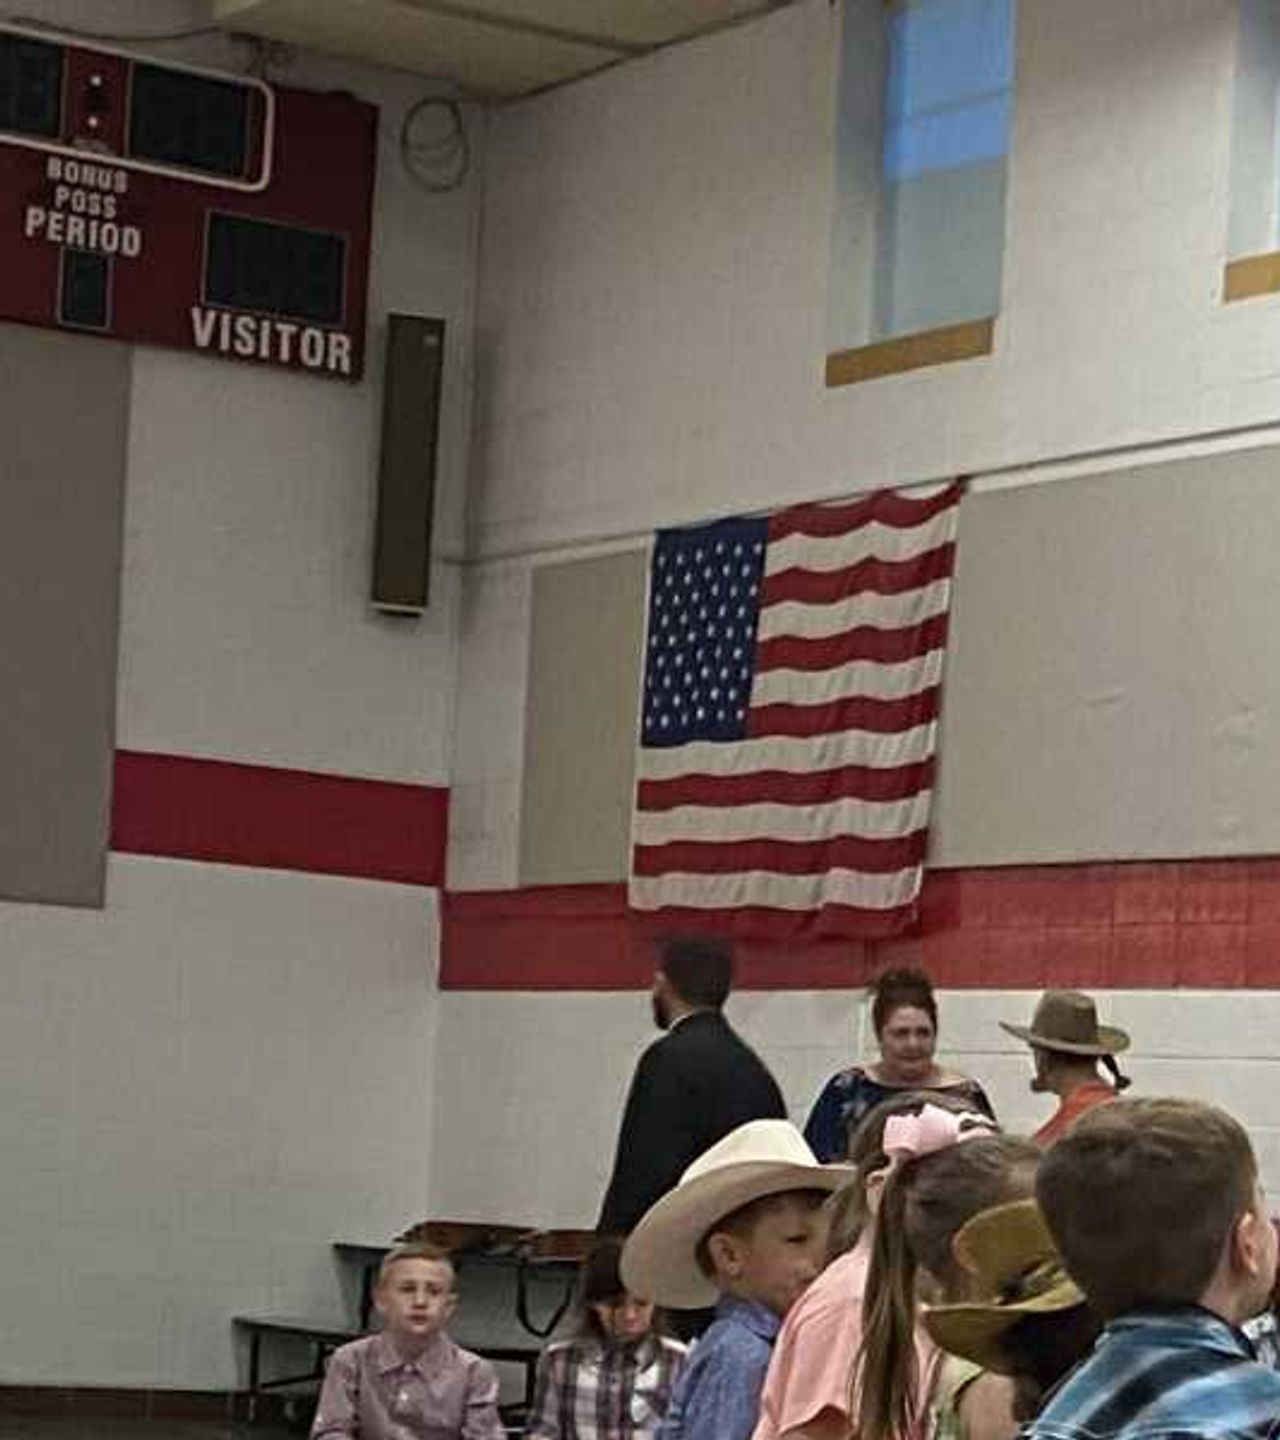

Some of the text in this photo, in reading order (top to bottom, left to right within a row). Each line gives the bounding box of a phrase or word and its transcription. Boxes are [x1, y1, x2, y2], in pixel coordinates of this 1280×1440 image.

[47, 156, 128, 194] BONUS
[55, 184, 118, 219] POSS
[25, 205, 142, 258] PERIOD
[190, 306, 352, 374] VISITOR
